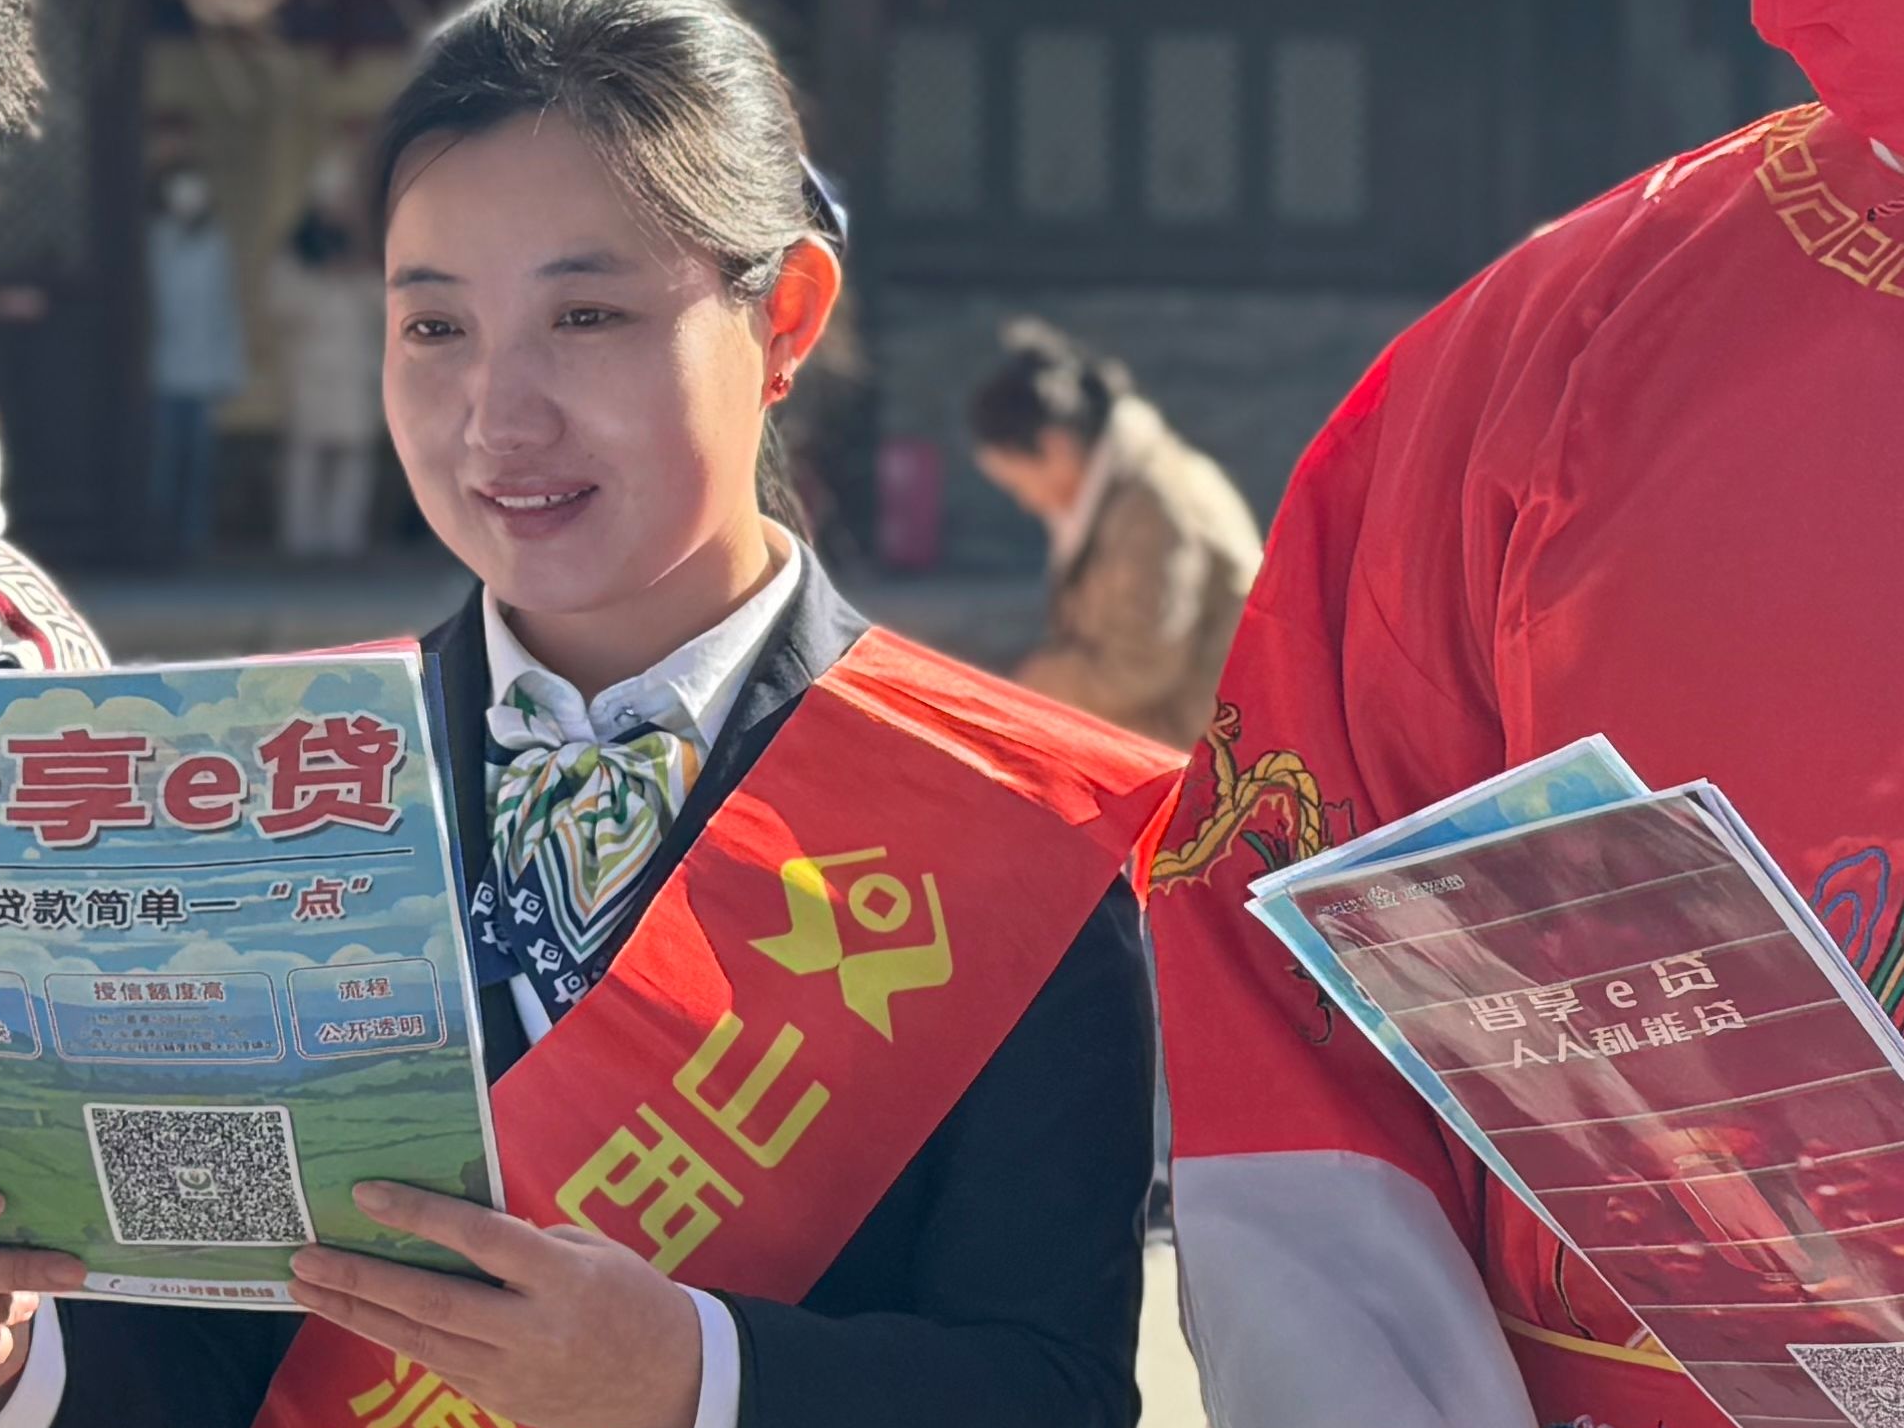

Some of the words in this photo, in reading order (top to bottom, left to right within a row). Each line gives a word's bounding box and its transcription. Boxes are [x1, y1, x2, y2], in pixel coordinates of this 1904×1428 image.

[93, 979, 227, 1003] 授信额度高
[337, 976, 393, 1001] 流程
[316, 1013, 425, 1045] 公开透明
[1513, 998, 1747, 1069] 人人都能贷
